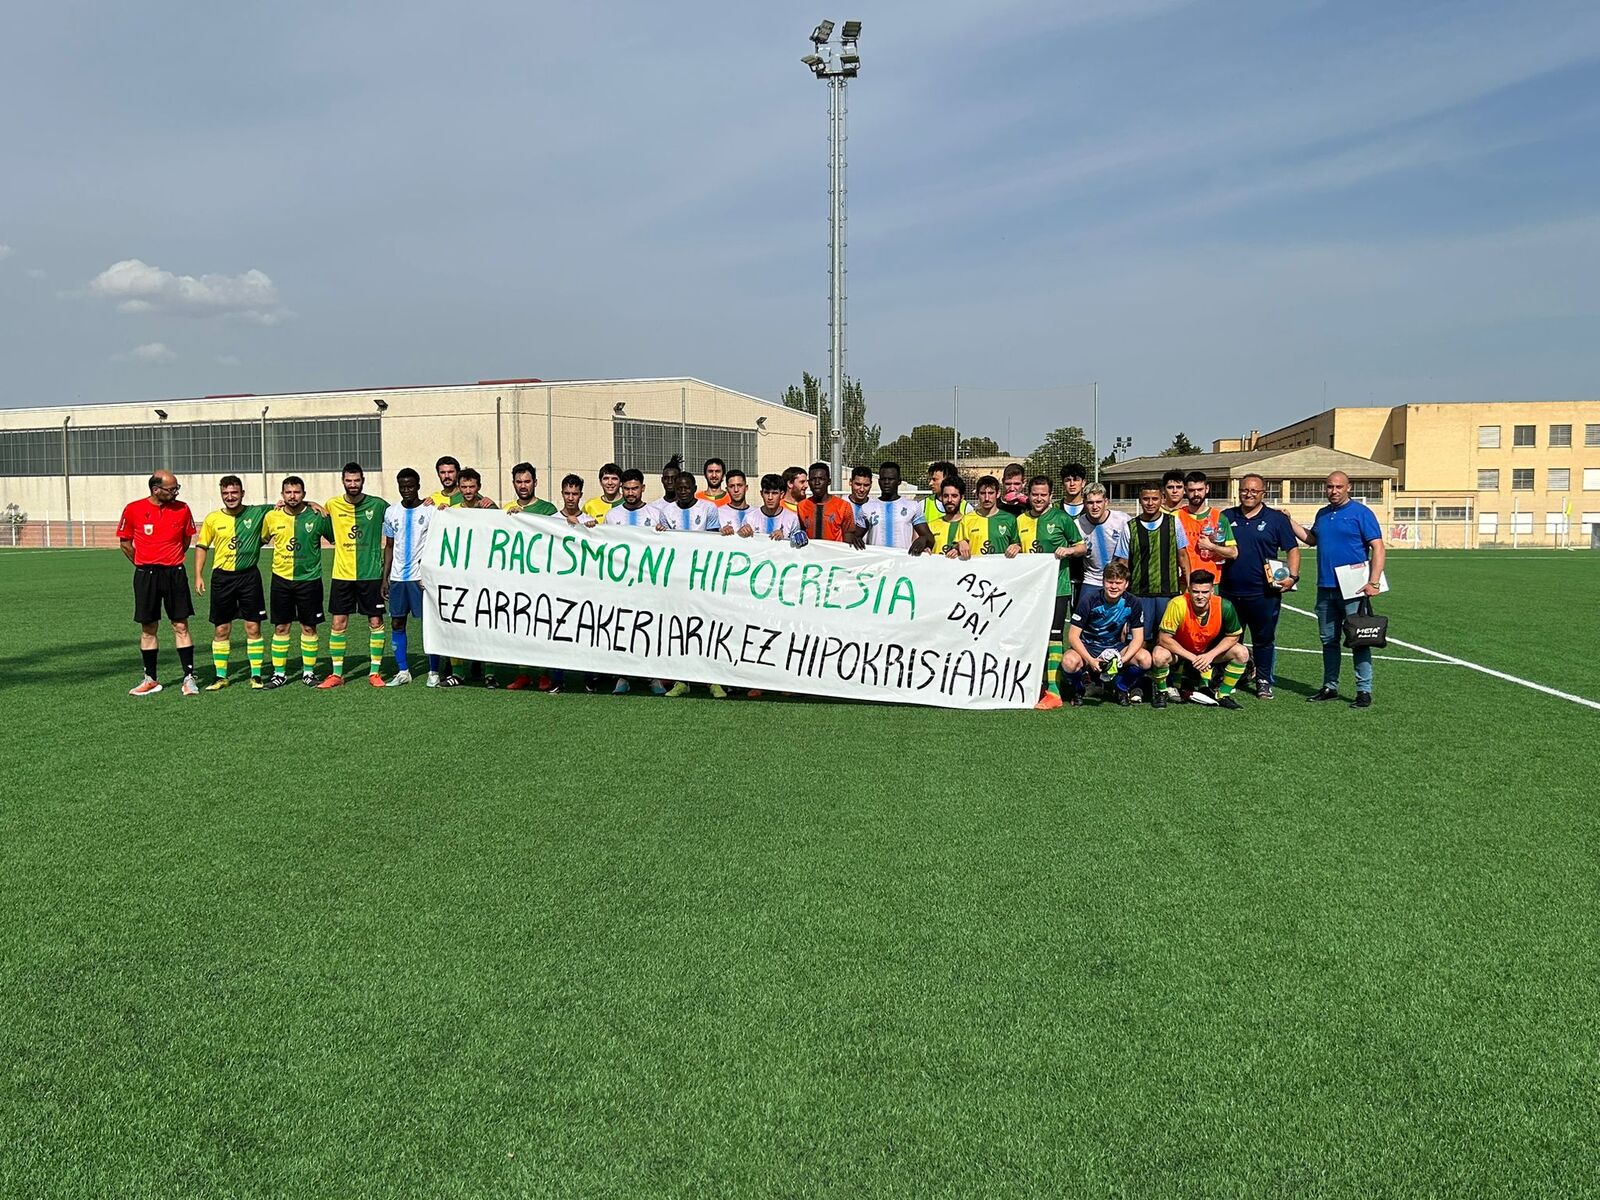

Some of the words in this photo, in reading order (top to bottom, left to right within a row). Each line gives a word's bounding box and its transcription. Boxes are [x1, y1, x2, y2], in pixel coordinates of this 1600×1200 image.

[438, 527, 474, 571] NI
[687, 548, 917, 619] HIPOCRESIA
[956, 573, 1013, 619] ASKI
[437, 584, 469, 625] EZ
[785, 631, 1033, 704] HIPOKRISIARIK
[947, 601, 990, 642] DA!
